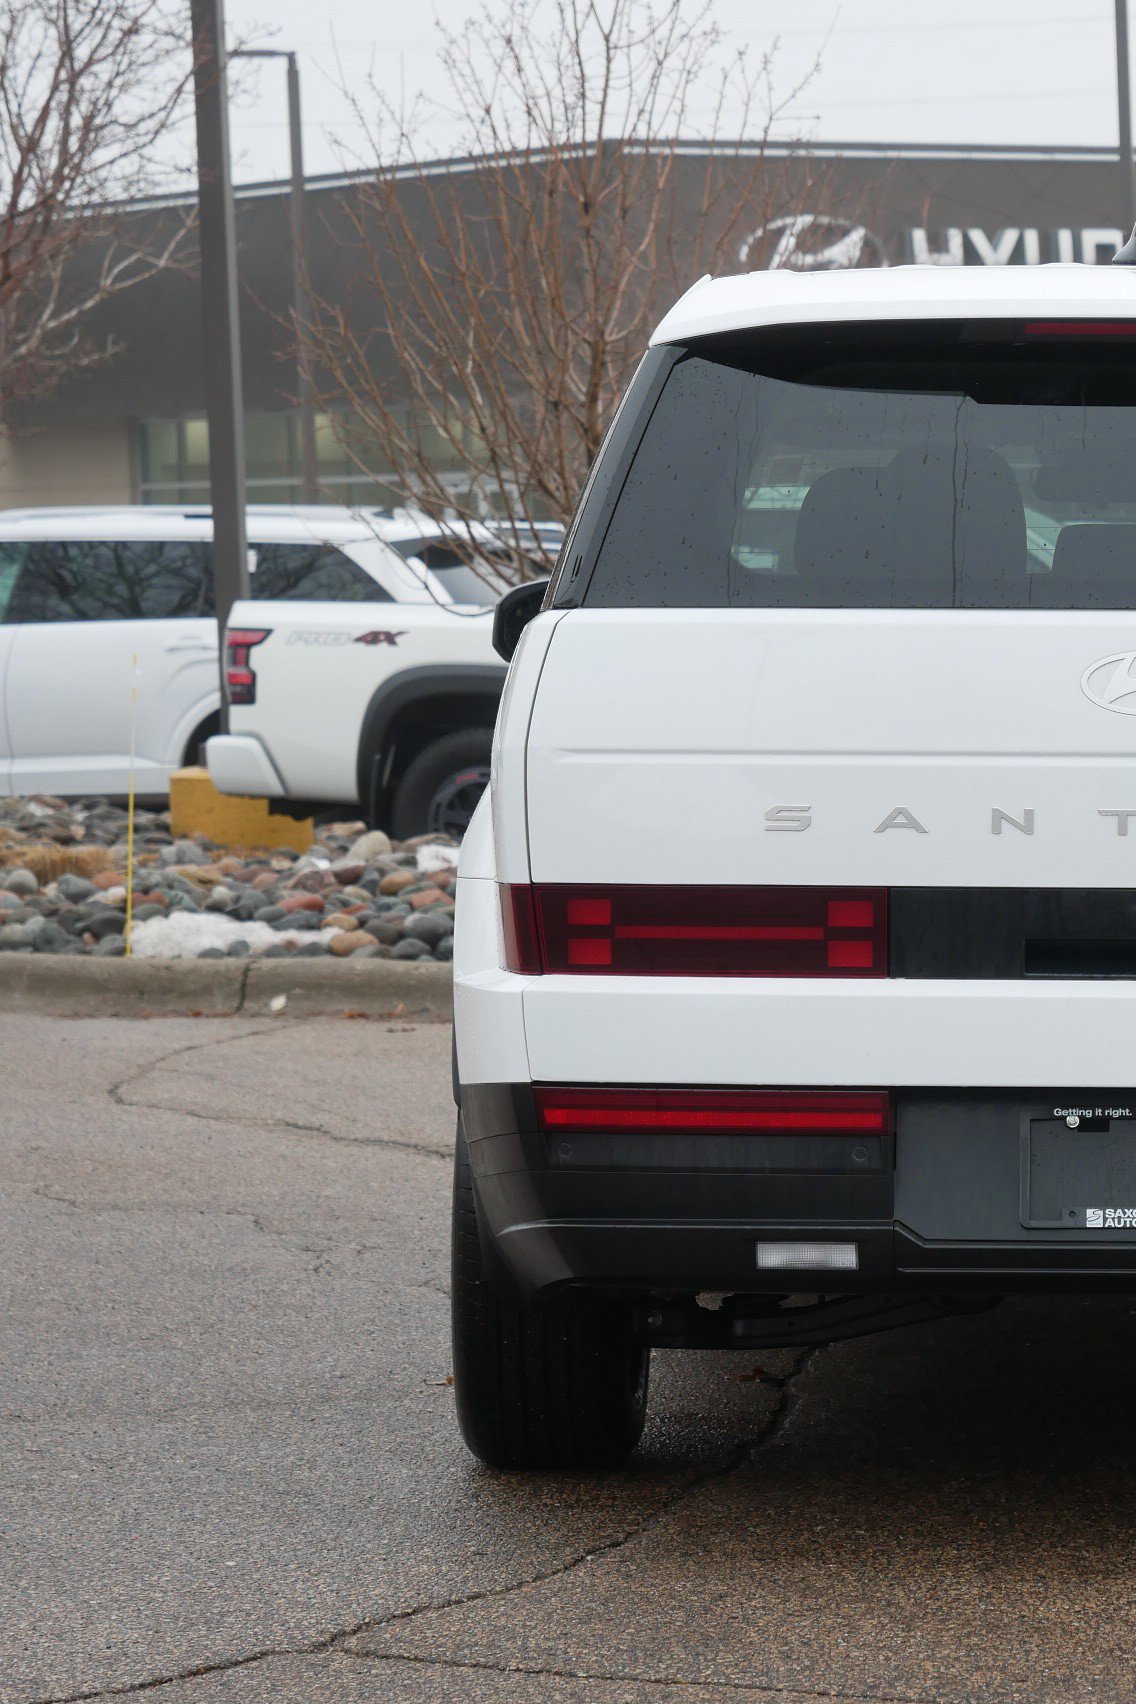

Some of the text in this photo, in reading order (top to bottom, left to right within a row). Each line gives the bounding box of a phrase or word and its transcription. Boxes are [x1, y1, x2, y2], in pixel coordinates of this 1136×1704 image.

[1053, 1108, 1093, 1118] Getting
[1095, 1108, 1103, 1116] it
[1105, 1108, 1133, 1118] right.
